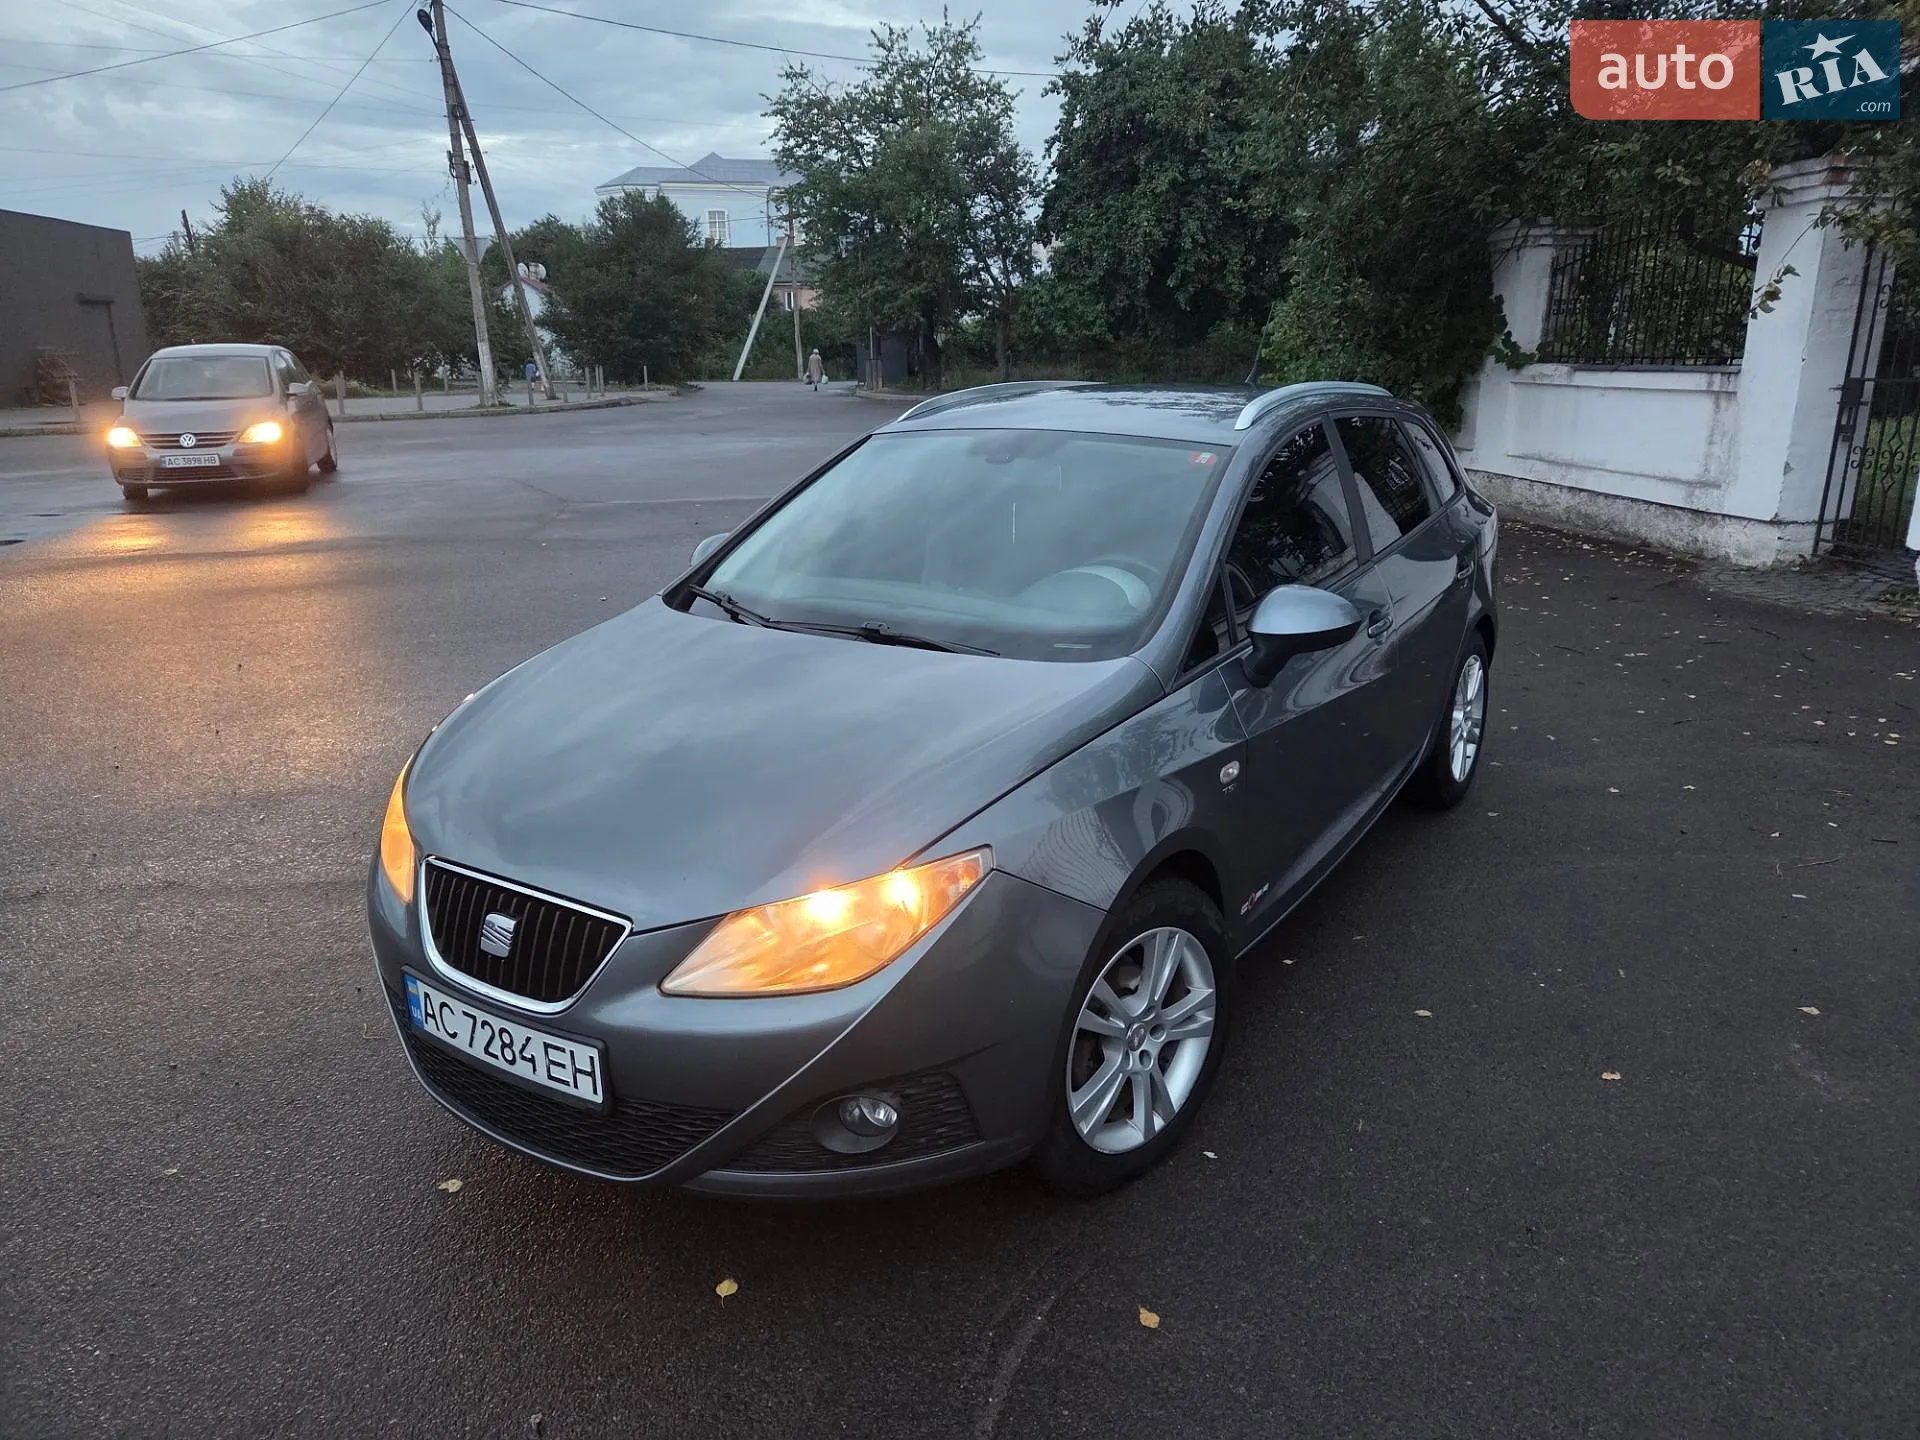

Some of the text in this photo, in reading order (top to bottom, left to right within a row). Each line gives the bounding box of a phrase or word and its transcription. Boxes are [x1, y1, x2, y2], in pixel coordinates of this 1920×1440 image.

[167, 457, 180, 466] AC
[423, 991, 598, 1096] AC 7284 EH
